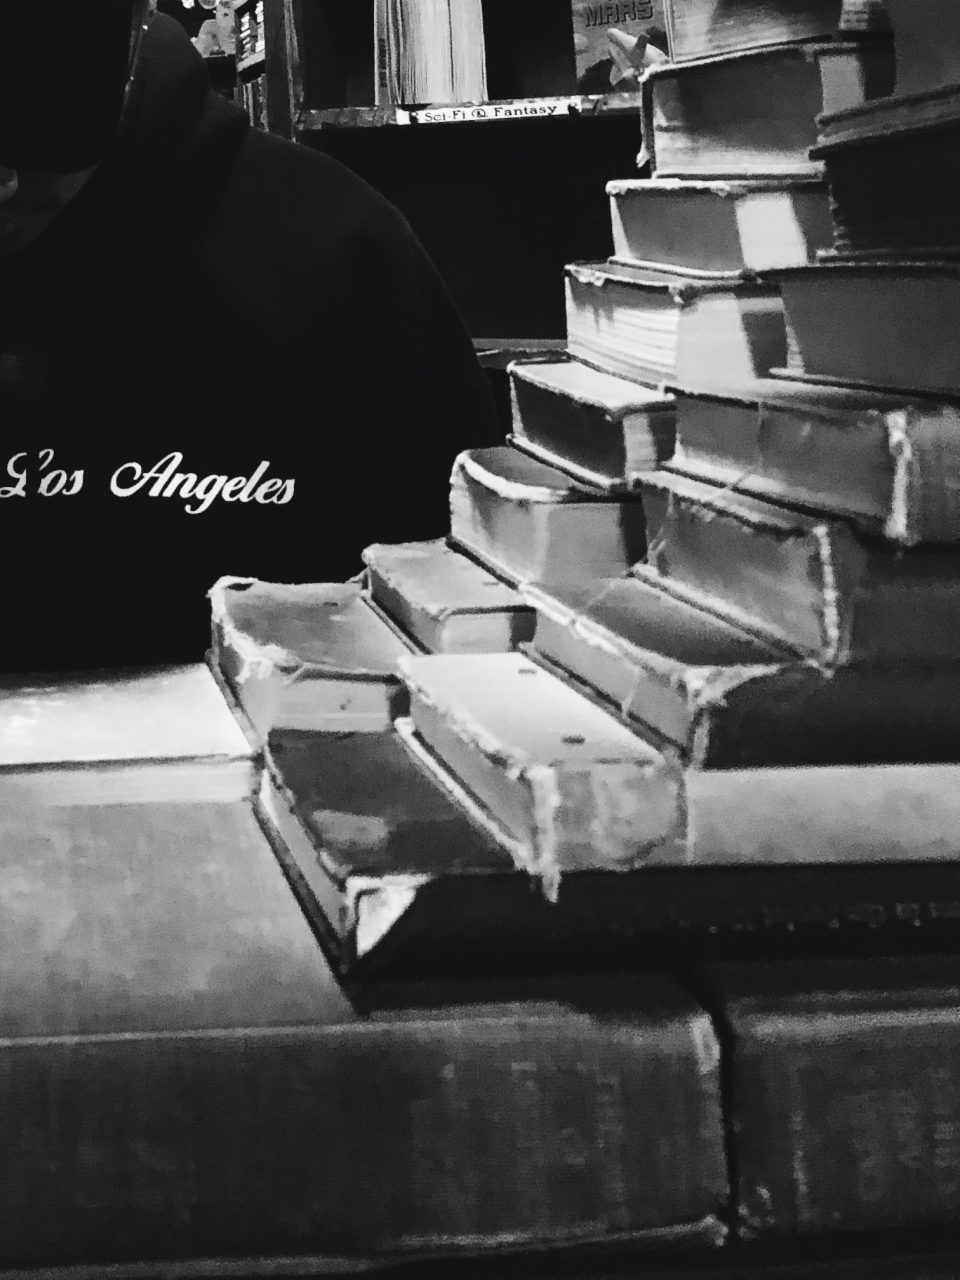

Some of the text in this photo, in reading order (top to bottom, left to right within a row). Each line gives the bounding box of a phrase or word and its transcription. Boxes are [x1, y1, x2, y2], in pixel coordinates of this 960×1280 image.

[424, 110, 467, 122] Sci-Fi
[493, 104, 558, 118] Fantasy
[110, 451, 296, 515] Angeles
